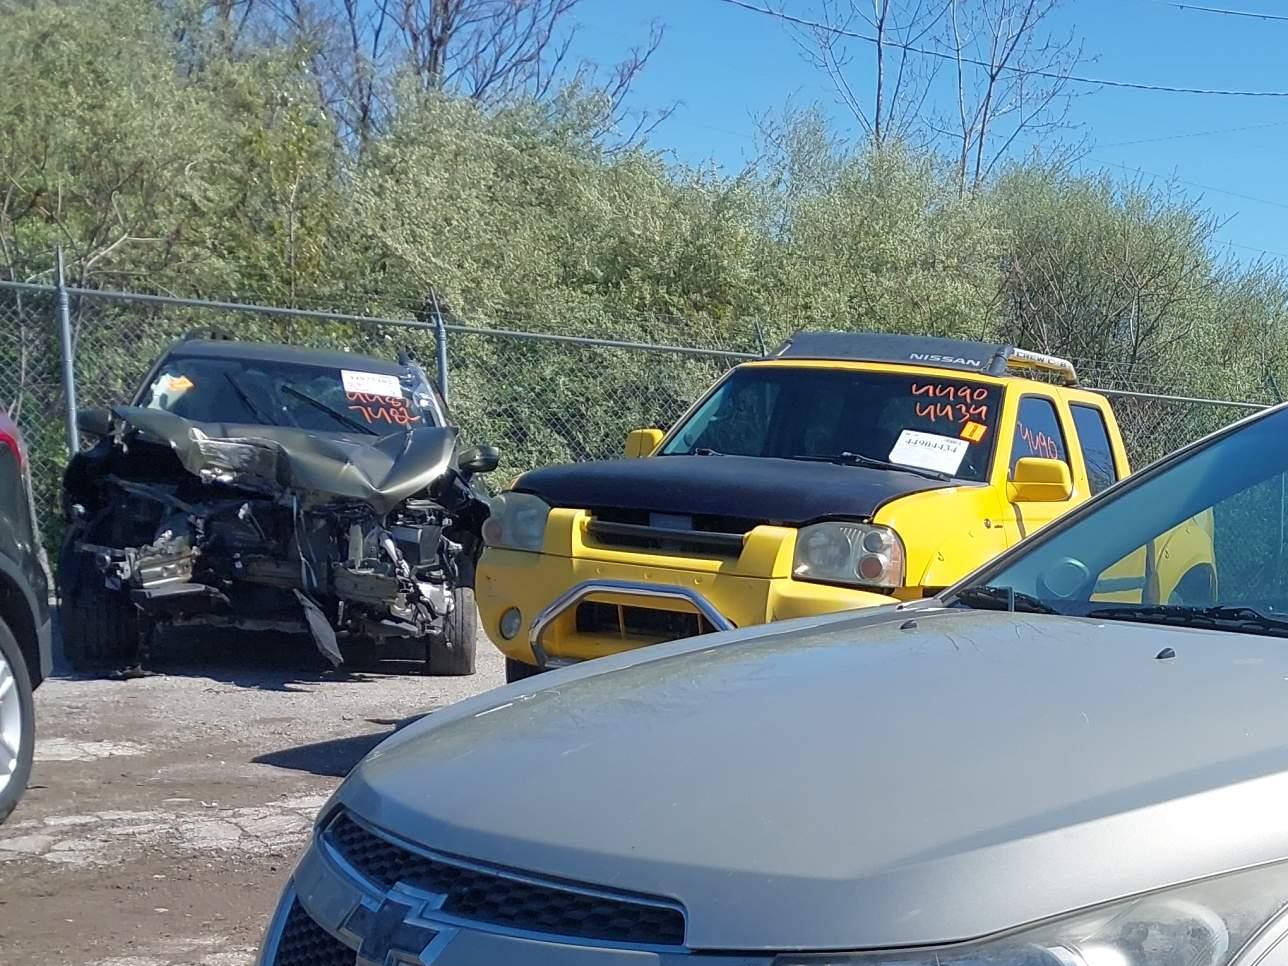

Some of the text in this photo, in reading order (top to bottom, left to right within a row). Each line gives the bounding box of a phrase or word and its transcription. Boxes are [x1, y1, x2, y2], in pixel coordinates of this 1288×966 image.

[909, 352, 981, 367] NISSAN
[911, 383, 989, 403] 4490
[348, 405, 421, 425] 7482
[915, 401, 988, 424] 4434
